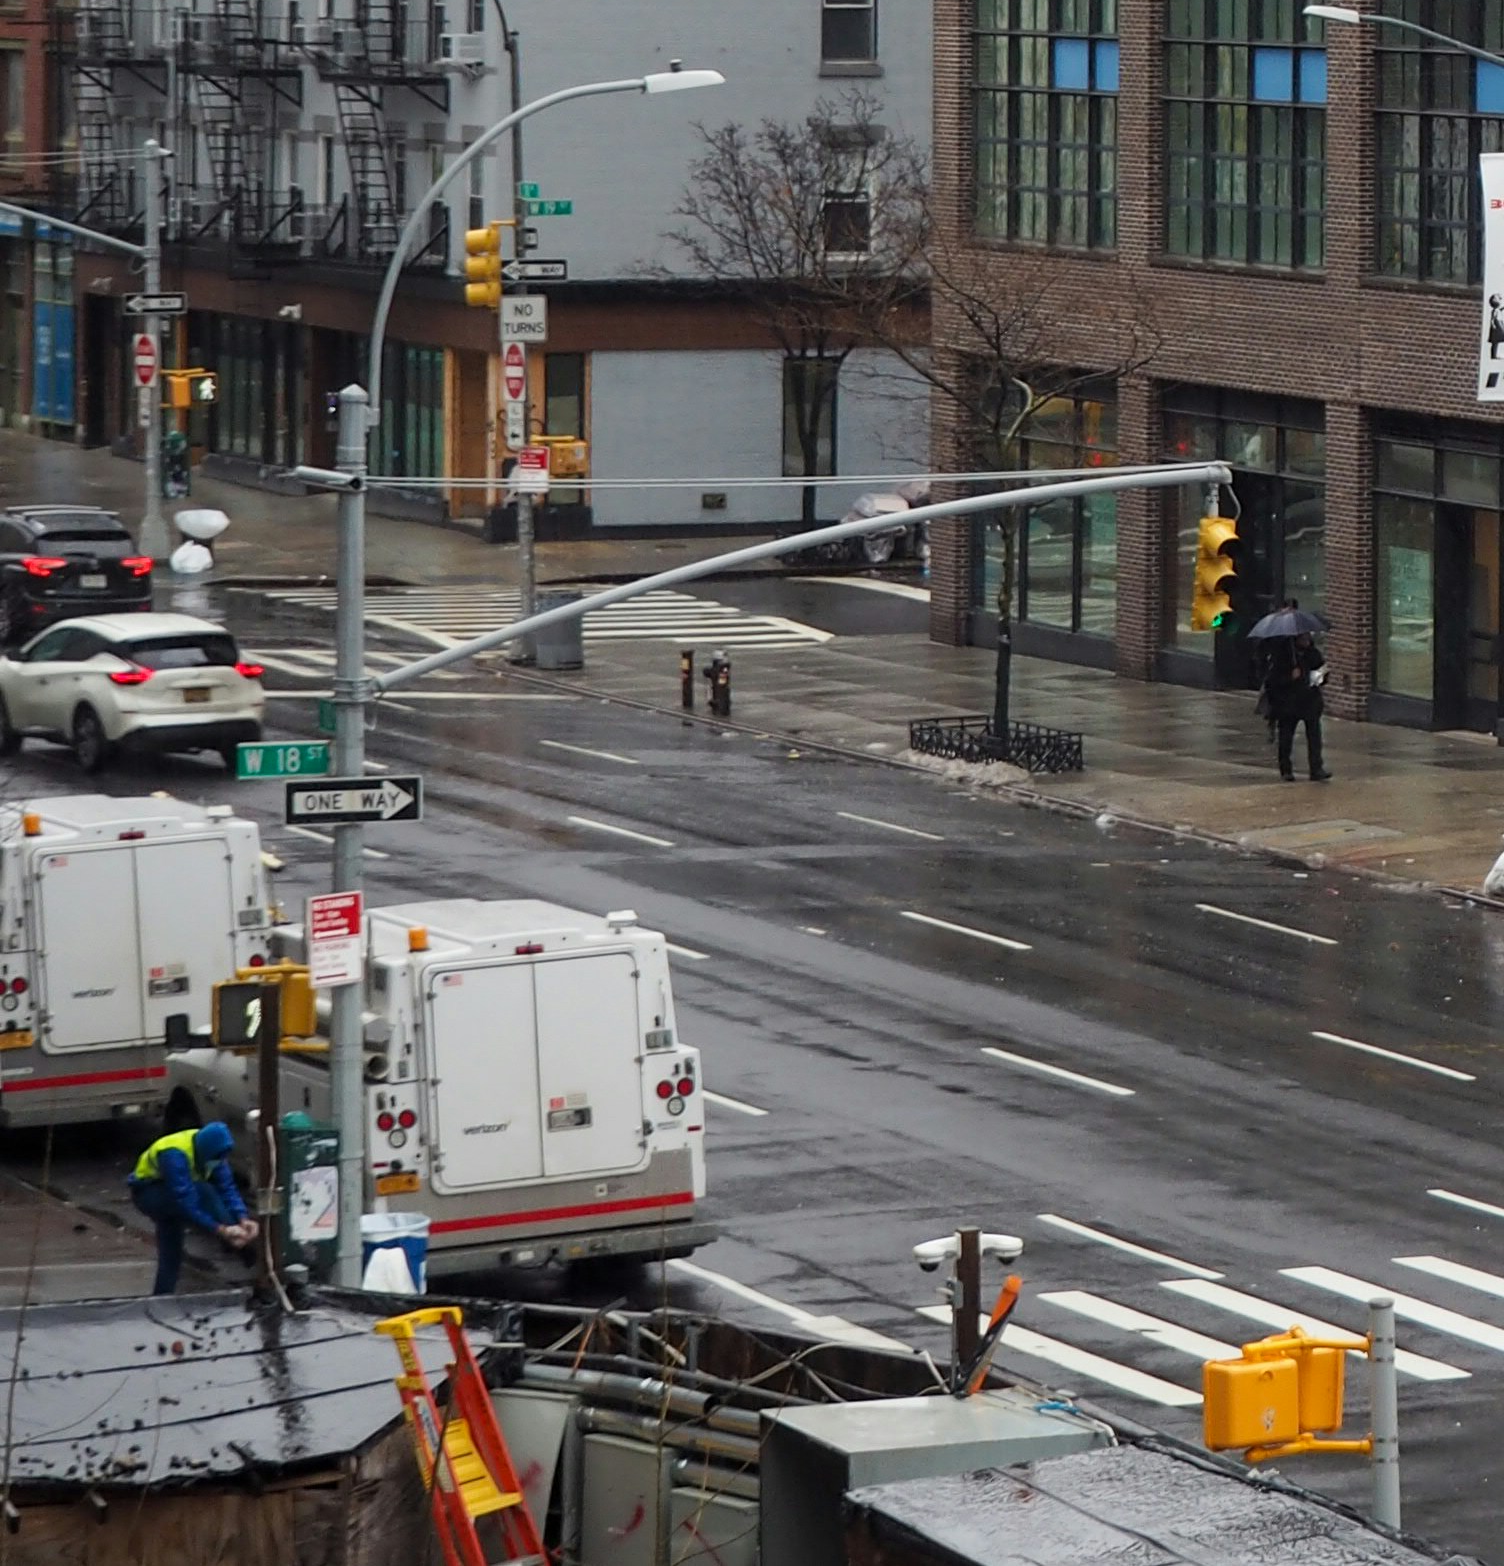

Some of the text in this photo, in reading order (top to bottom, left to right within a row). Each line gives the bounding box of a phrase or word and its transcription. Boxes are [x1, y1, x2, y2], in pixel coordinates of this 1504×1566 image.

[513, 303, 533, 317] NO
[504, 322, 545, 335] TURNS
[244, 746, 323, 772] W 18 ST
[304, 790, 401, 811] ONE WAY
[463, 1121, 512, 1135] verizon
